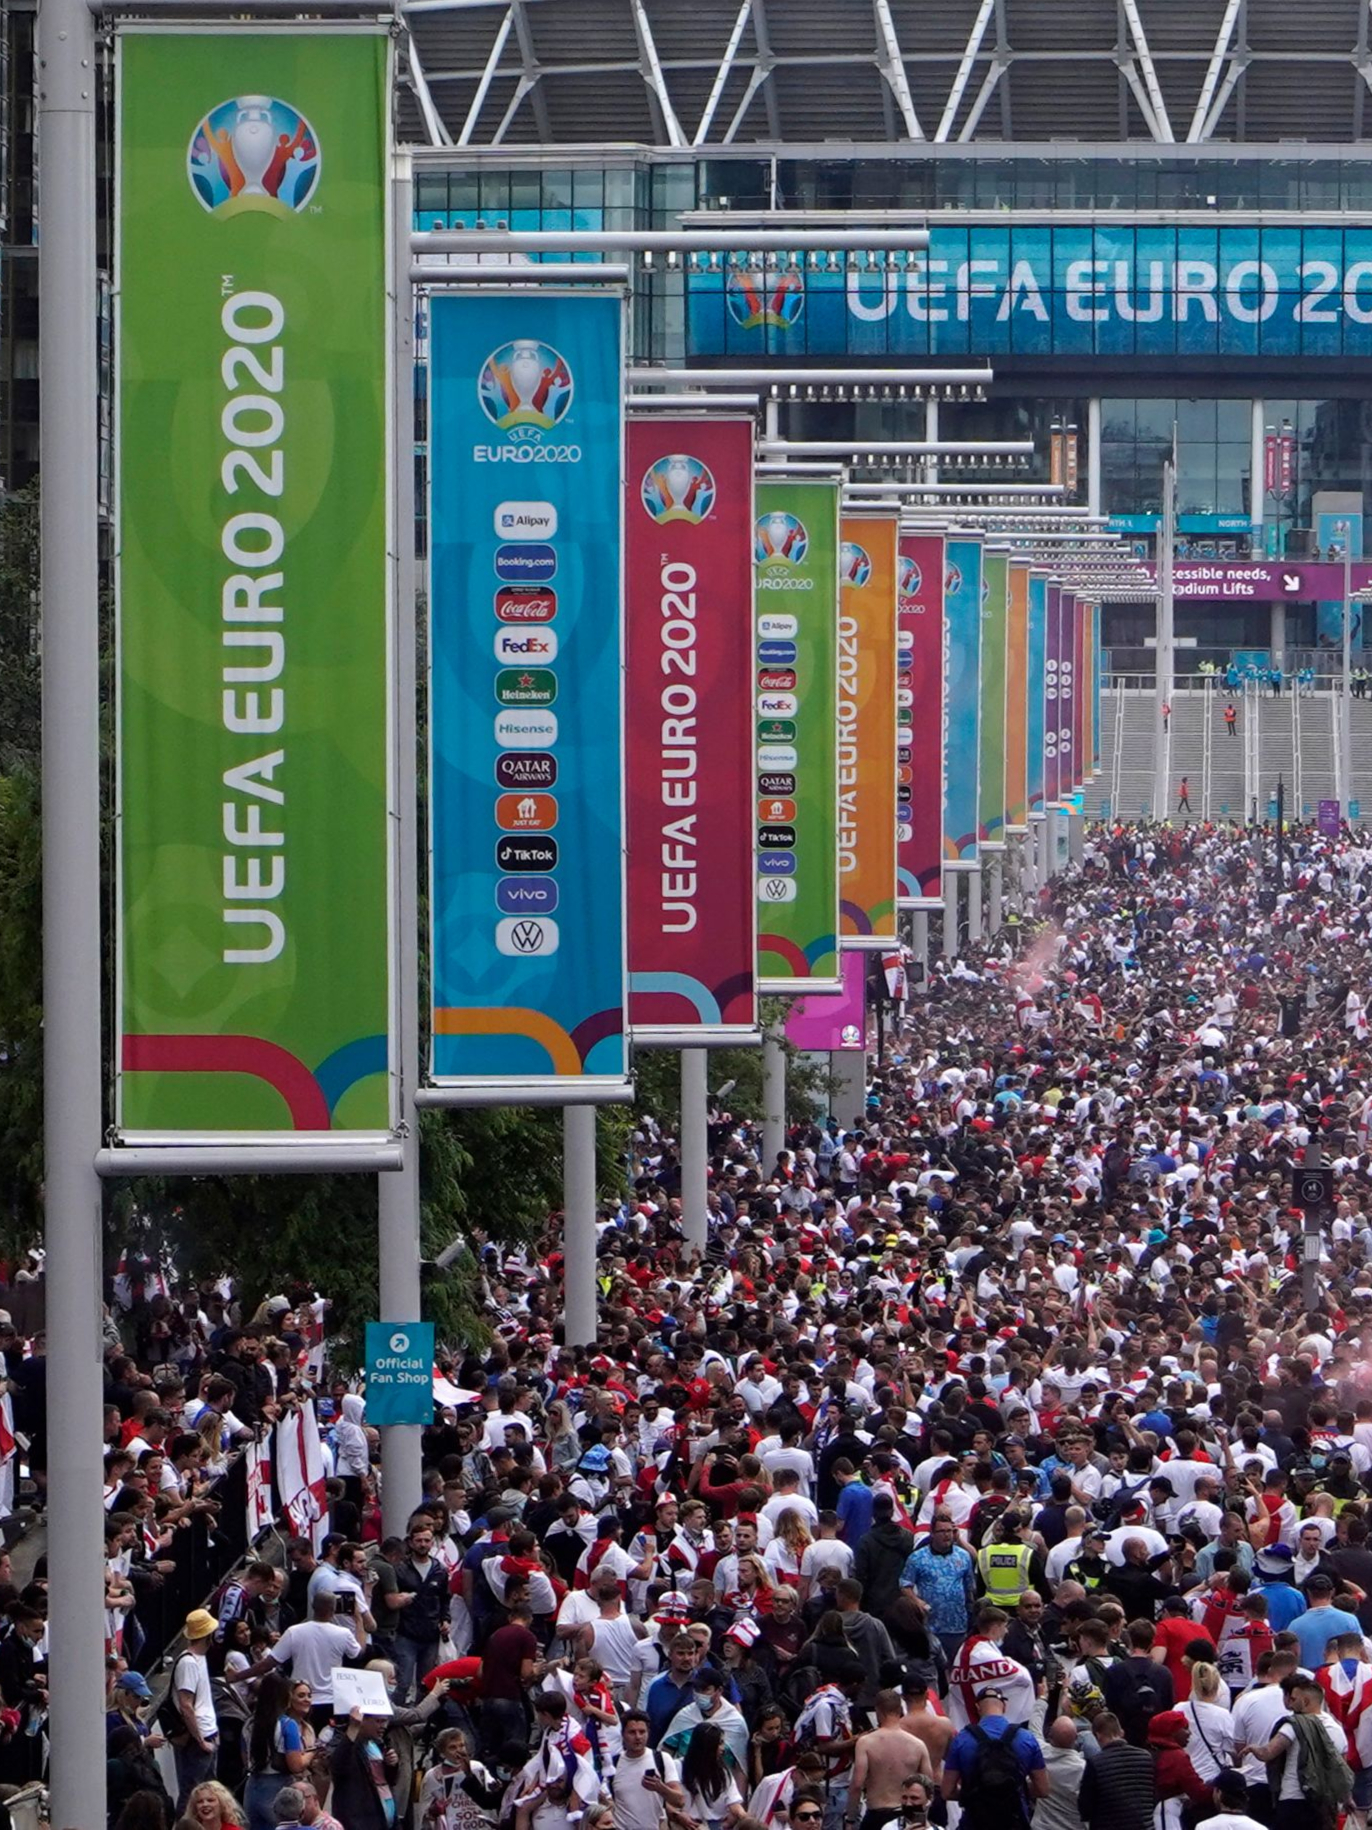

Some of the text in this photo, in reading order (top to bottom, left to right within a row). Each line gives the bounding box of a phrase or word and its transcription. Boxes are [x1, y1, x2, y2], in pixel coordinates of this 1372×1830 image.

[847, 260, 1050, 322] UEFA
[1066, 260, 1279, 323] EURO
[221, 290, 285, 497] 2020
[509, 428, 542, 442] UEFA
[473, 445, 582, 463] EURO2020
[516, 515, 550, 527] Alipay
[1218, 519, 1248, 528] NORTH
[497, 557, 554, 568] Booking.com
[1154, 568, 1225, 580] cessible
[1227, 568, 1271, 582] needs,
[755, 578, 814, 590] URO2020
[1171, 583, 1254, 595] tadium Lifts
[221, 512, 285, 734] EURO
[660, 561, 698, 677] 2020
[502, 638, 549, 653] FedEx
[501, 689, 550, 700] Heineken
[762, 700, 792, 711] FedEx
[498, 723, 554, 734] Hisense
[661, 685, 698, 807] EURO
[839, 616, 859, 873] UEFA EURO 2020
[501, 760, 550, 773] QATAR
[513, 773, 551, 781] AIRWAYS
[760, 778, 793, 786] QATAR
[221, 748, 285, 964] UEFA
[514, 849, 554, 861] TikTok
[764, 858, 790, 867] vivo
[661, 814, 698, 933] UEFA
[507, 888, 548, 900] vivo
[375, 1359, 423, 1369] Official
[370, 1372, 429, 1385] Fan Shop
[990, 1556, 1017, 1567] POLICE
[951, 1661, 1013, 1682] GLAND
